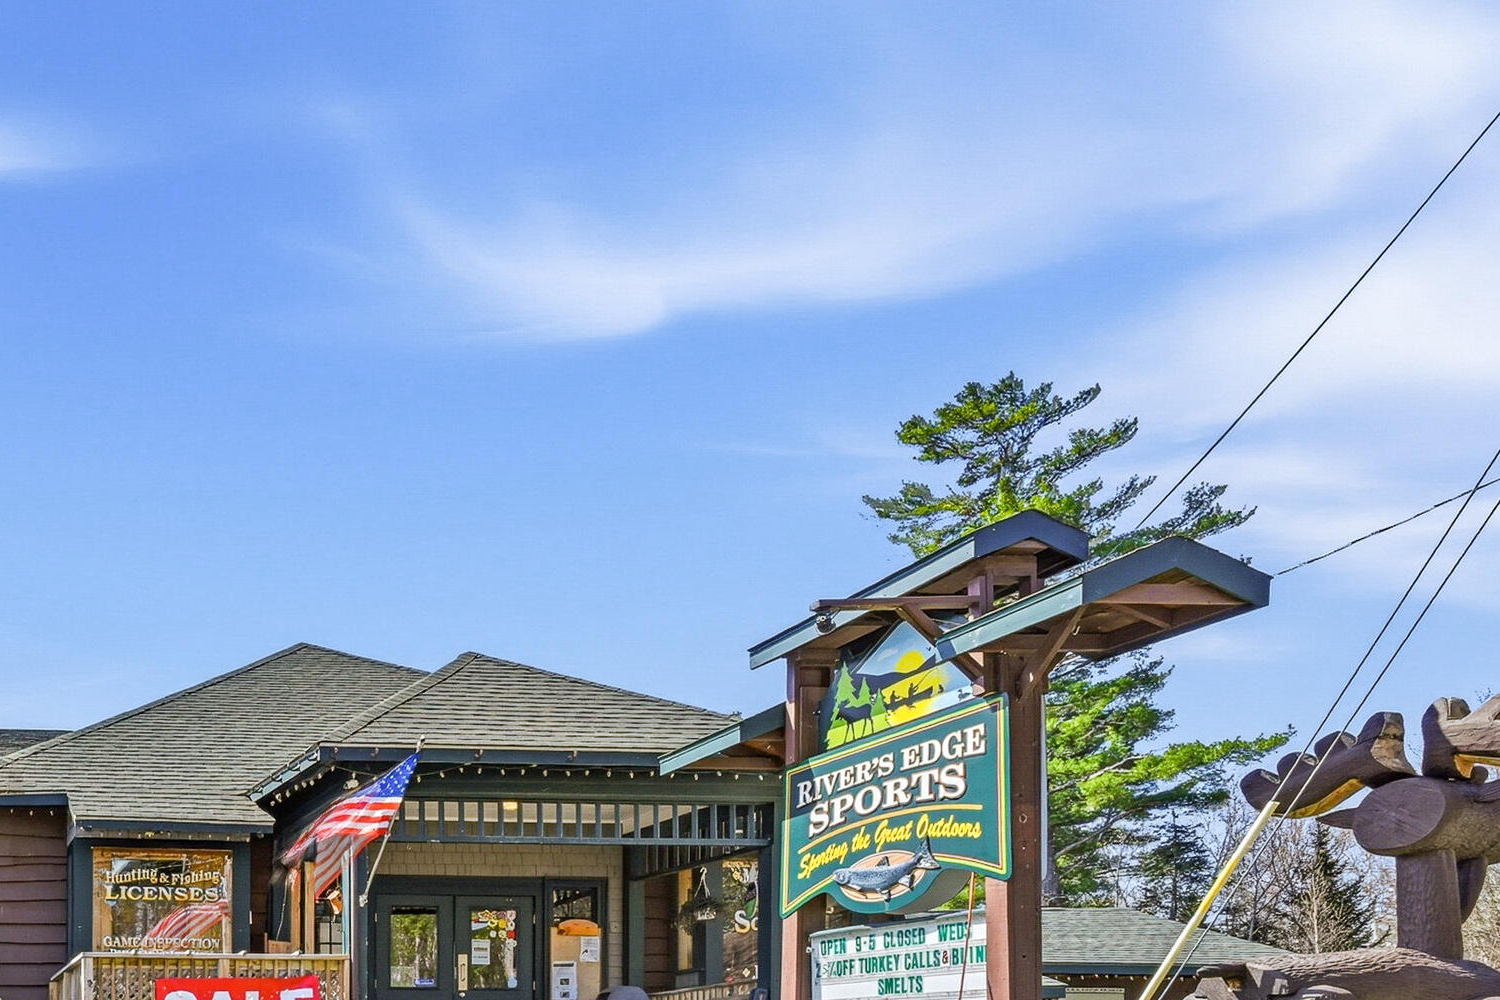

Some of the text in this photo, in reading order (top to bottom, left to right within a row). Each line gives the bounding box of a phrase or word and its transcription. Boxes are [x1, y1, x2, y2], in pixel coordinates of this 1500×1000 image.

[796, 723, 986, 809] RIVER'S EDGE
[809, 762, 967, 838] SPORTS
[797, 813, 982, 880] Sporting the Great Outdoors
[105, 868, 220, 886] Hunting & Fishing
[103, 885, 220, 901] LICENSES
[820, 937, 847, 956] OPEN
[855, 933, 876, 951] 9-5
[883, 927, 926, 949] CLOSED
[858, 954, 901, 974] TURKEY
[904, 949, 941, 970] CALLS
[942, 950, 949, 964] &
[878, 975, 923, 995] SMELTS
